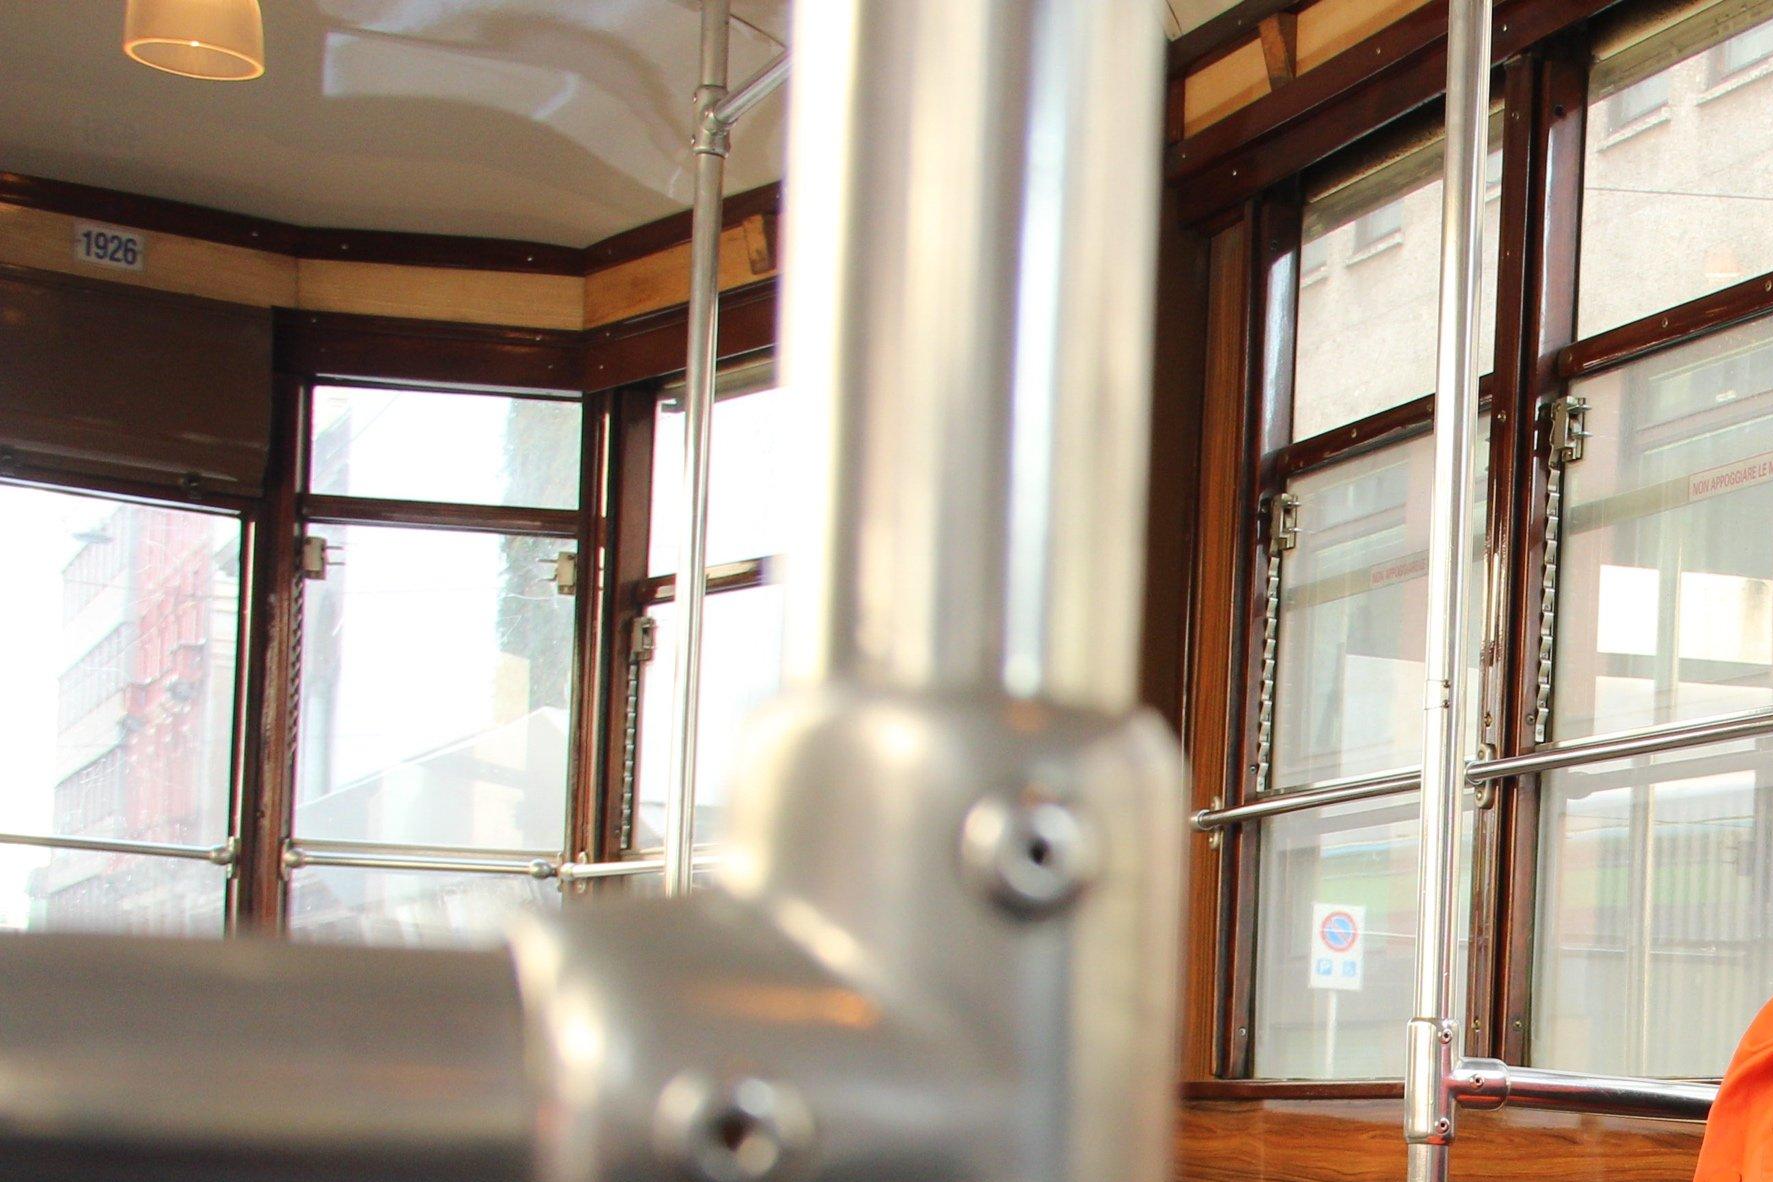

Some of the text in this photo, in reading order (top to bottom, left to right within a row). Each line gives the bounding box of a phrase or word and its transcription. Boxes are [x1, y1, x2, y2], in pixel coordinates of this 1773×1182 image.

[82, 230, 138, 266] 1926
[1692, 480, 1710, 497] NON
[1758, 462, 1768, 478] LE
